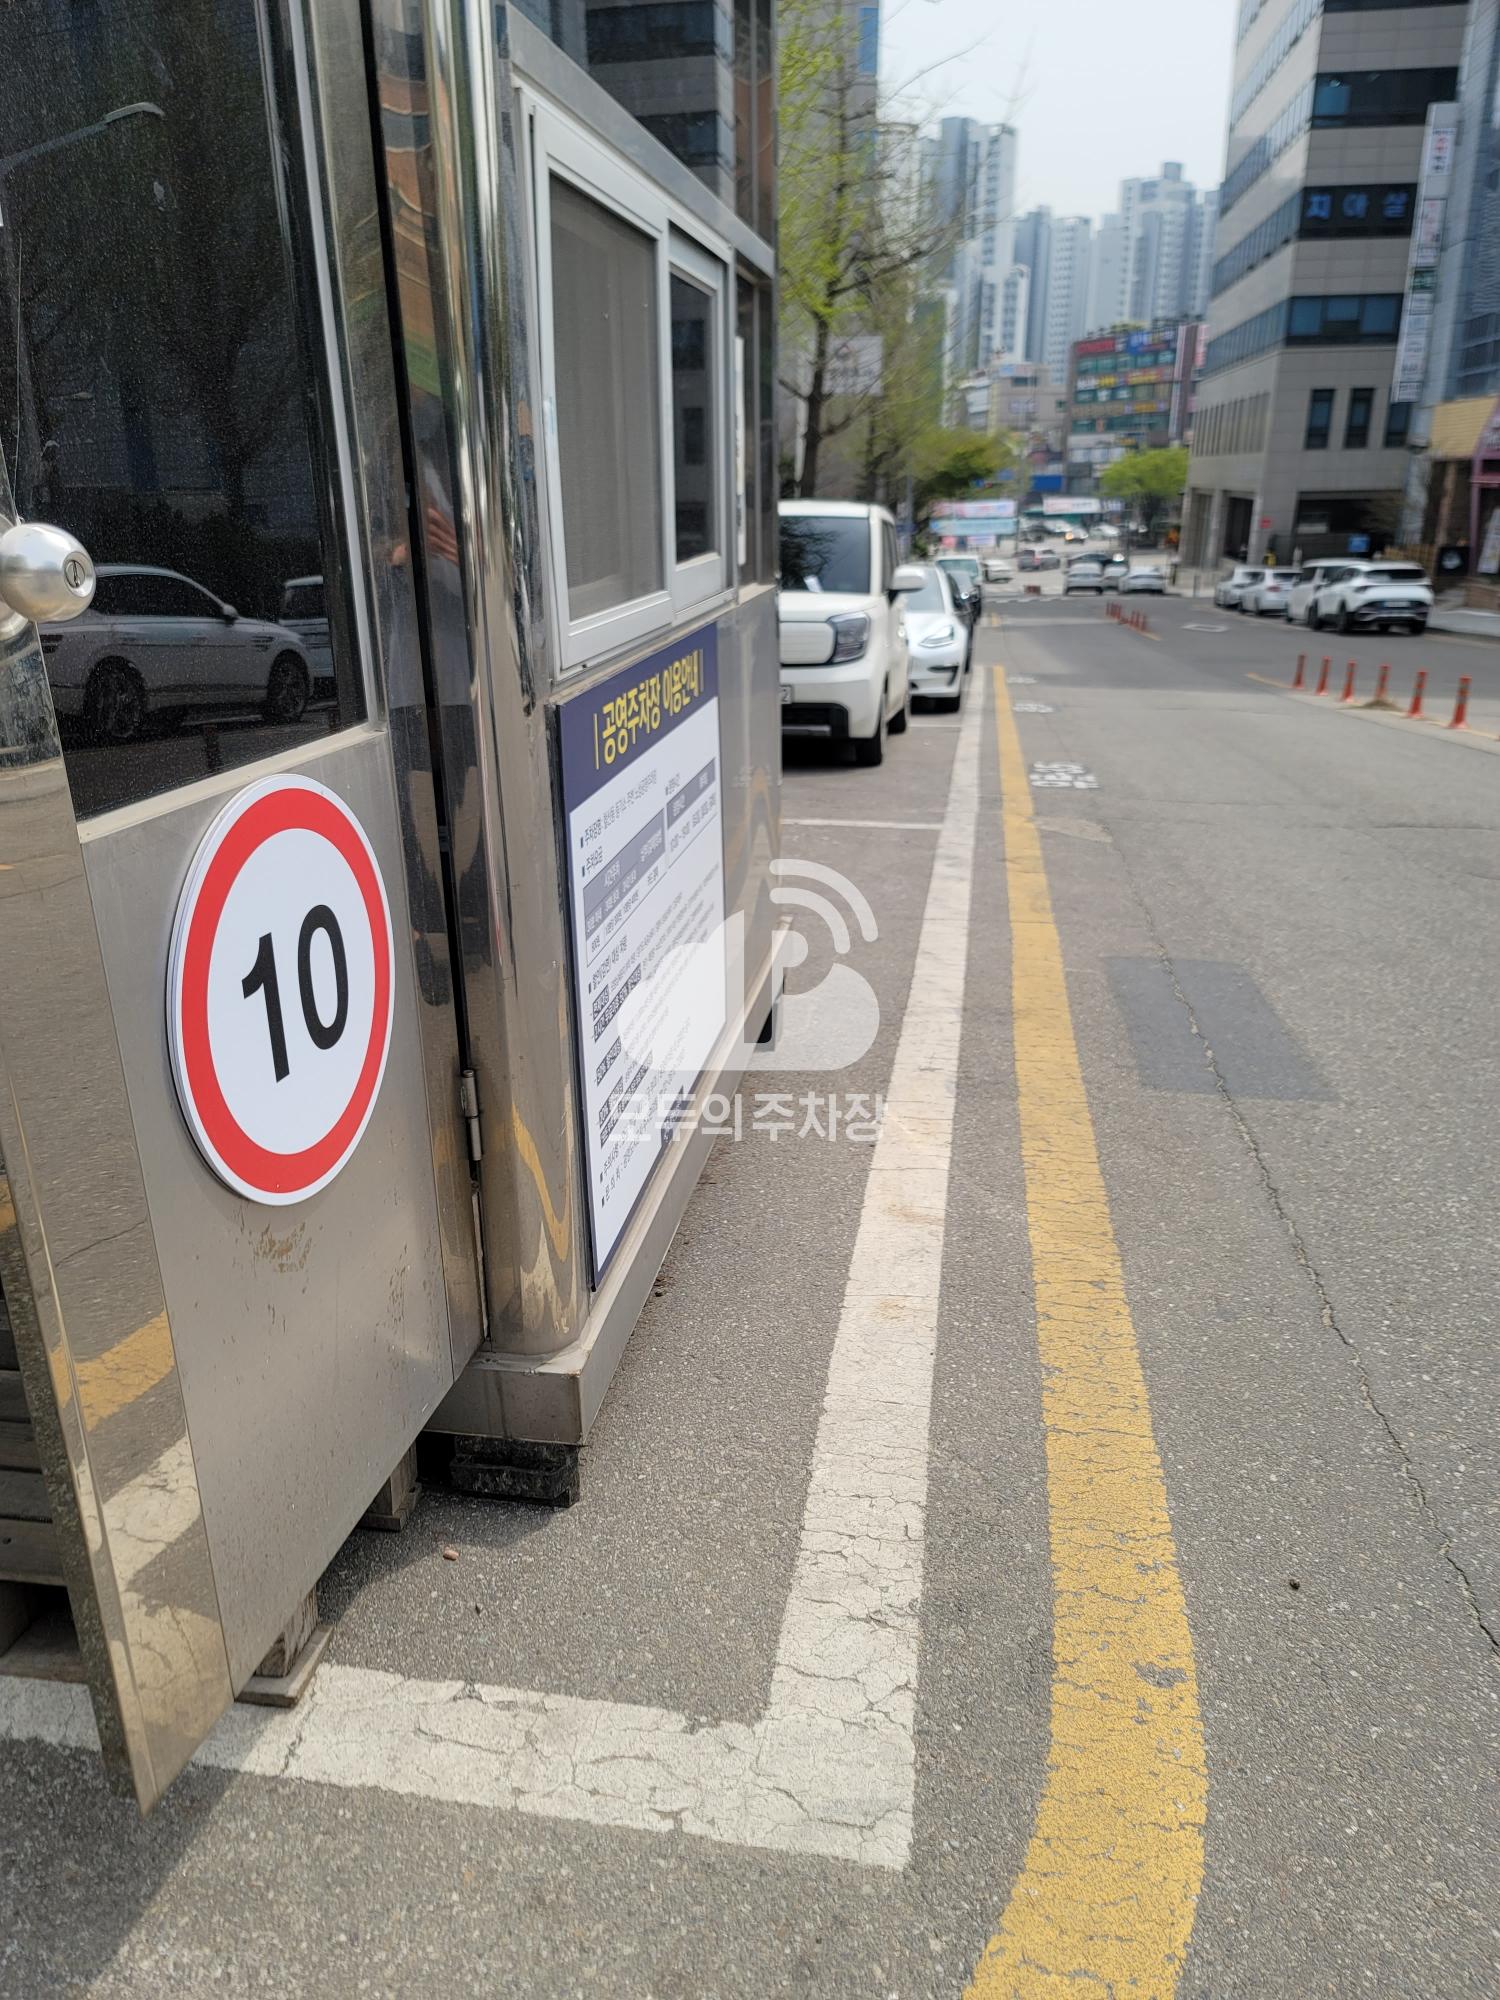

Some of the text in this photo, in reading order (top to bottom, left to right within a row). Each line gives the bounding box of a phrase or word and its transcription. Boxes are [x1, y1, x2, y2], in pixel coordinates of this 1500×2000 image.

[603, 651, 699, 764] 공영주차장 이용안내
[241, 904, 349, 1083] 10
